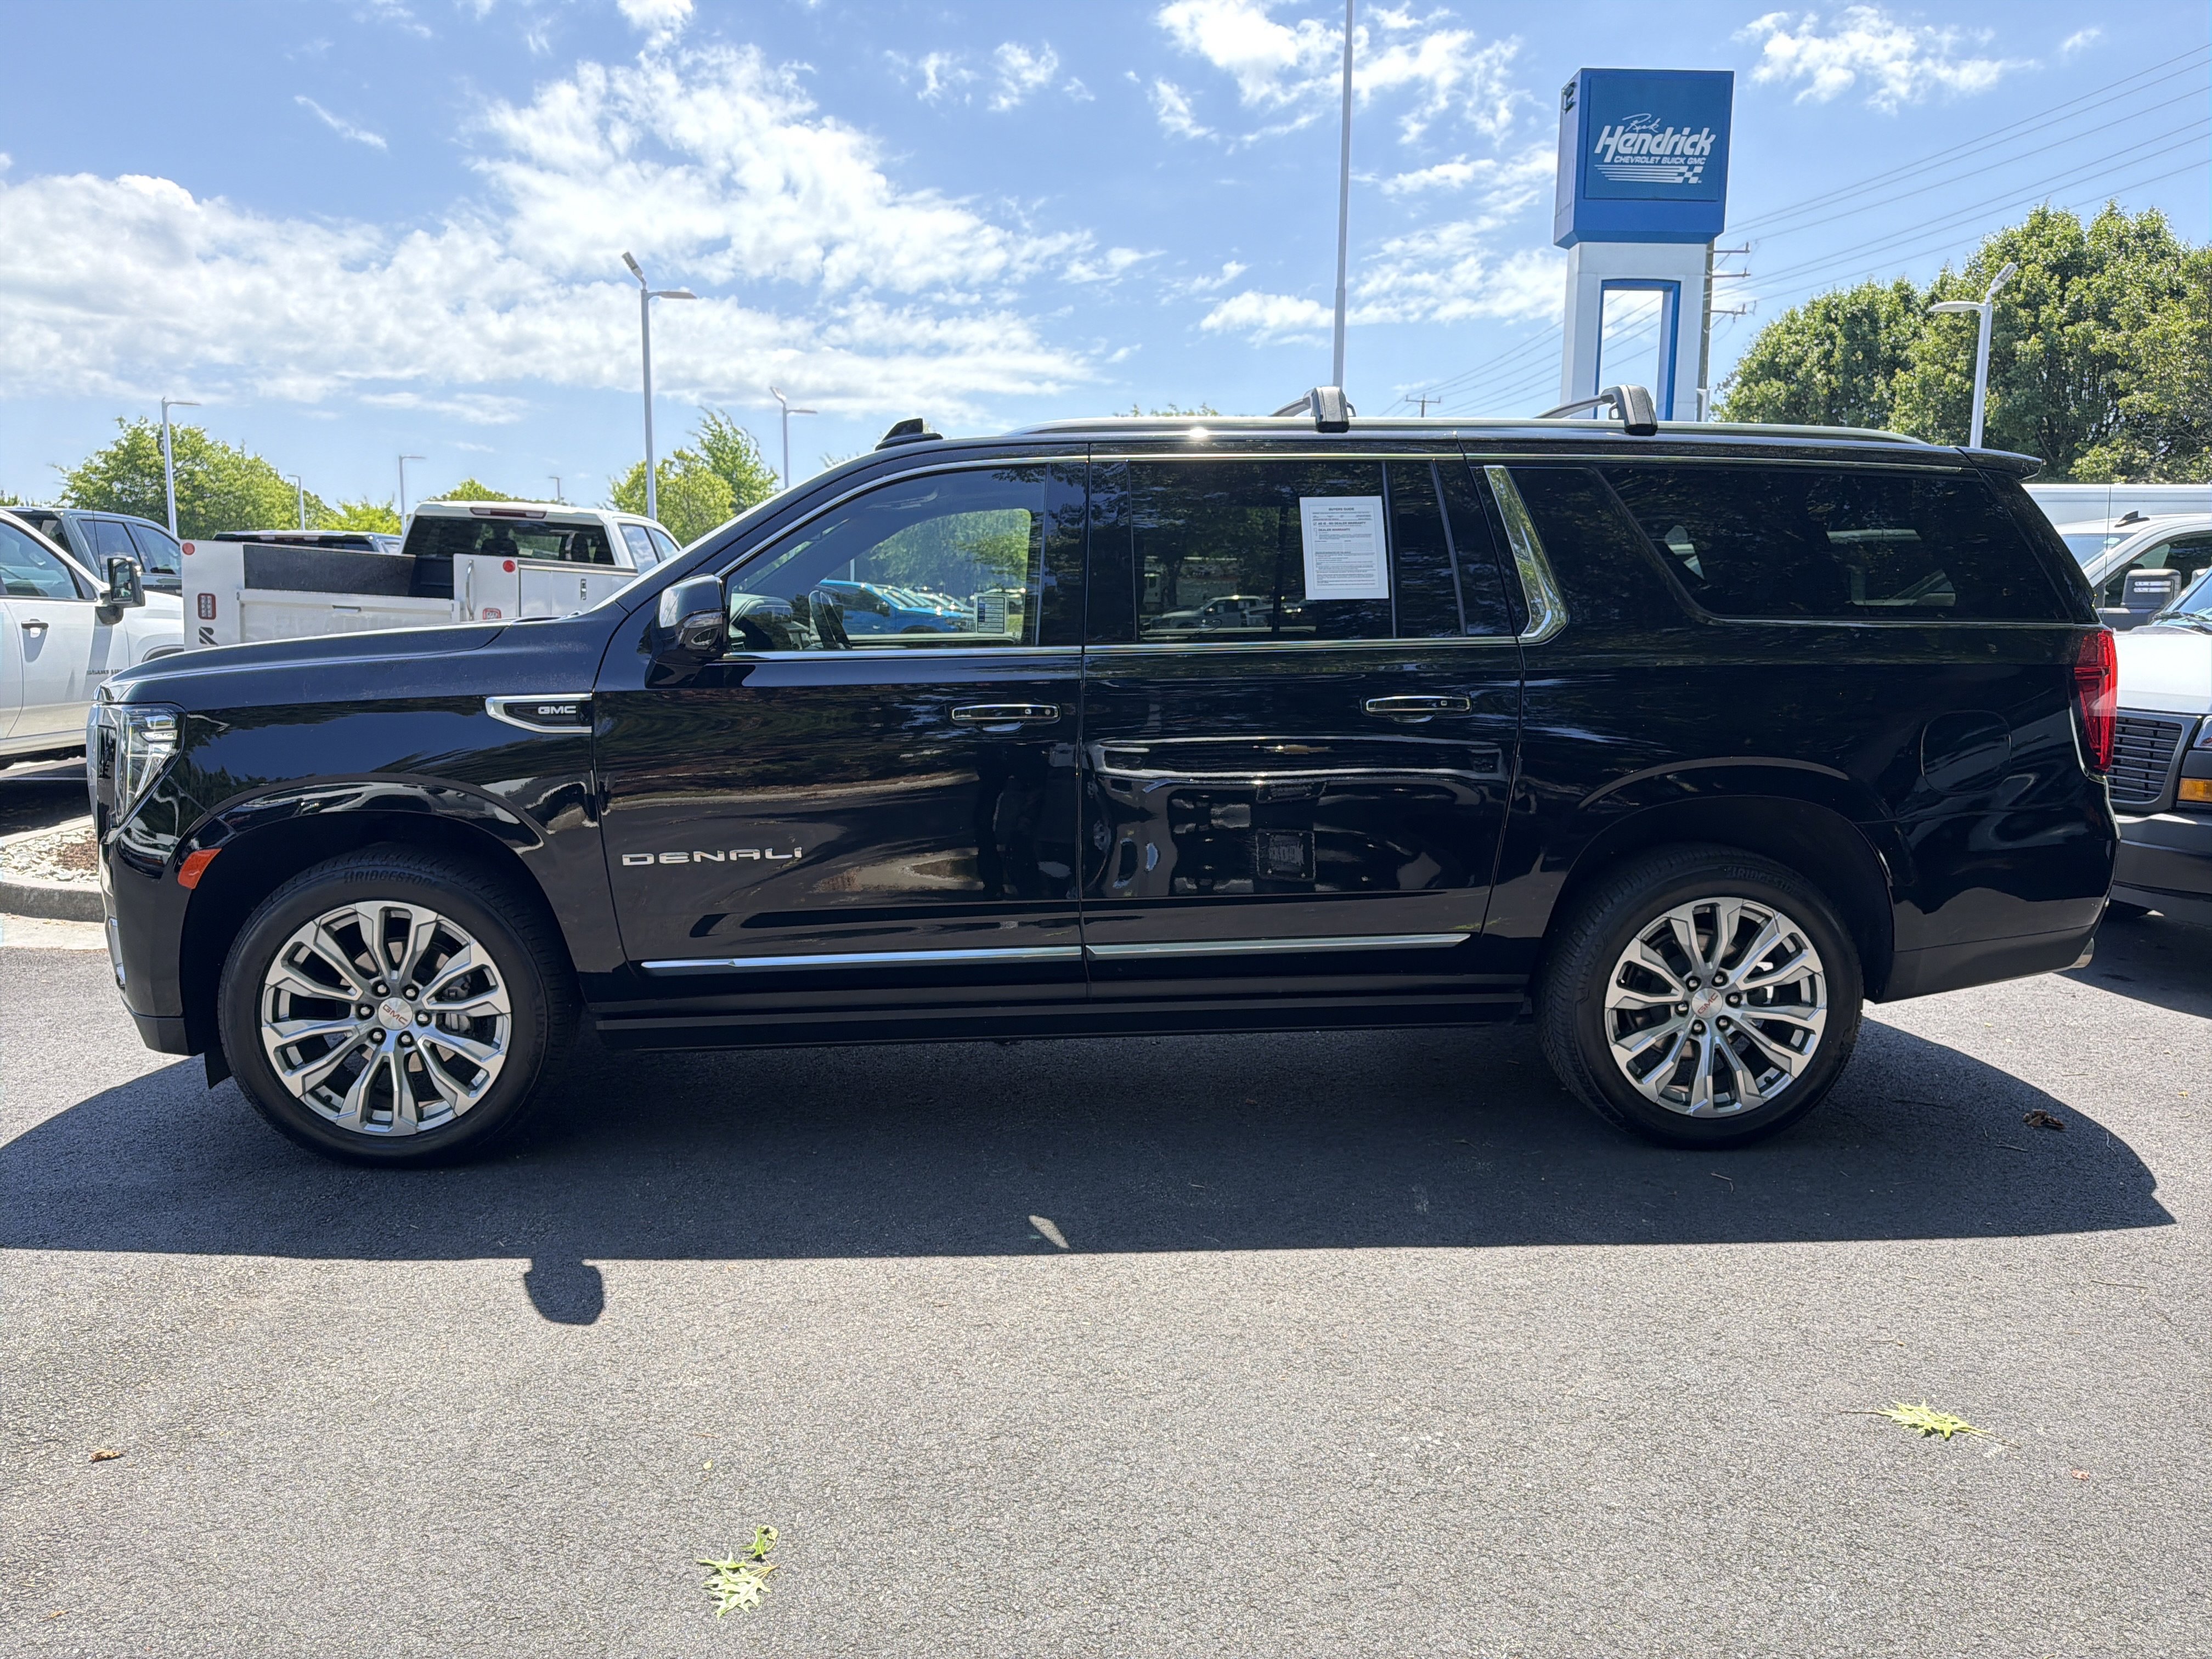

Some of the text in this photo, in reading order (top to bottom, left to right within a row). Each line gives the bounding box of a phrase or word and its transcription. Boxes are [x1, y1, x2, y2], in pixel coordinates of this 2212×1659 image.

[1594, 125, 1716, 162] Hendrick
[1613, 155, 1661, 164] CHEVROLET
[538, 705, 577, 714] GMC
[622, 847, 802, 866] DENALI
[1697, 992, 1718, 1014] GMC
[382, 1004, 408, 1025] GMC
